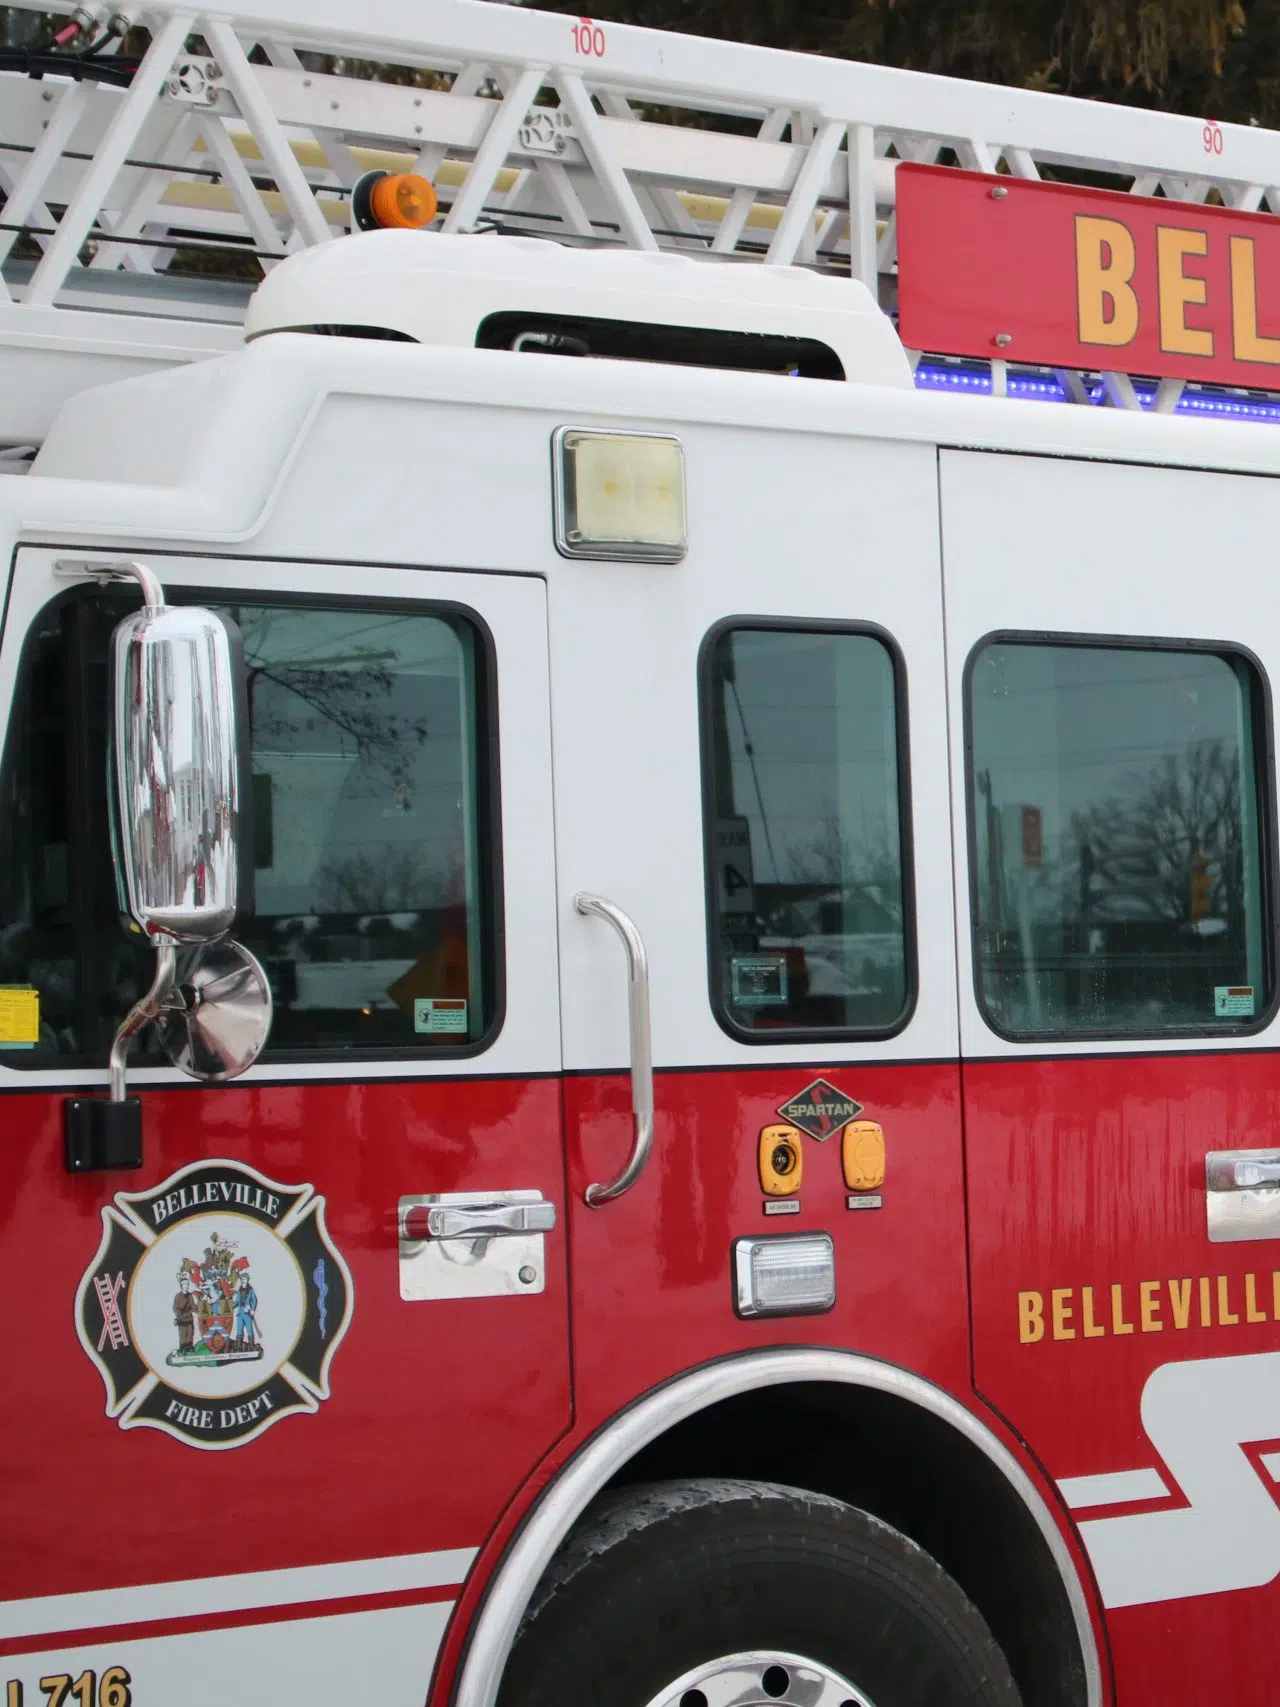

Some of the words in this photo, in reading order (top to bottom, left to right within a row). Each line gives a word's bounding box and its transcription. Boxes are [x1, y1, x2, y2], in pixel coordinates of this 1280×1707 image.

[571, 24, 605, 57] 100
[1203, 126, 1223, 154] 90
[788, 1102, 854, 1118] SPARTAN
[151, 1181, 280, 1226] BELLEVILLE
[165, 1399, 213, 1429] FIRE
[220, 1390, 274, 1429] DEPT
[40, 1665, 132, 1707] 716
